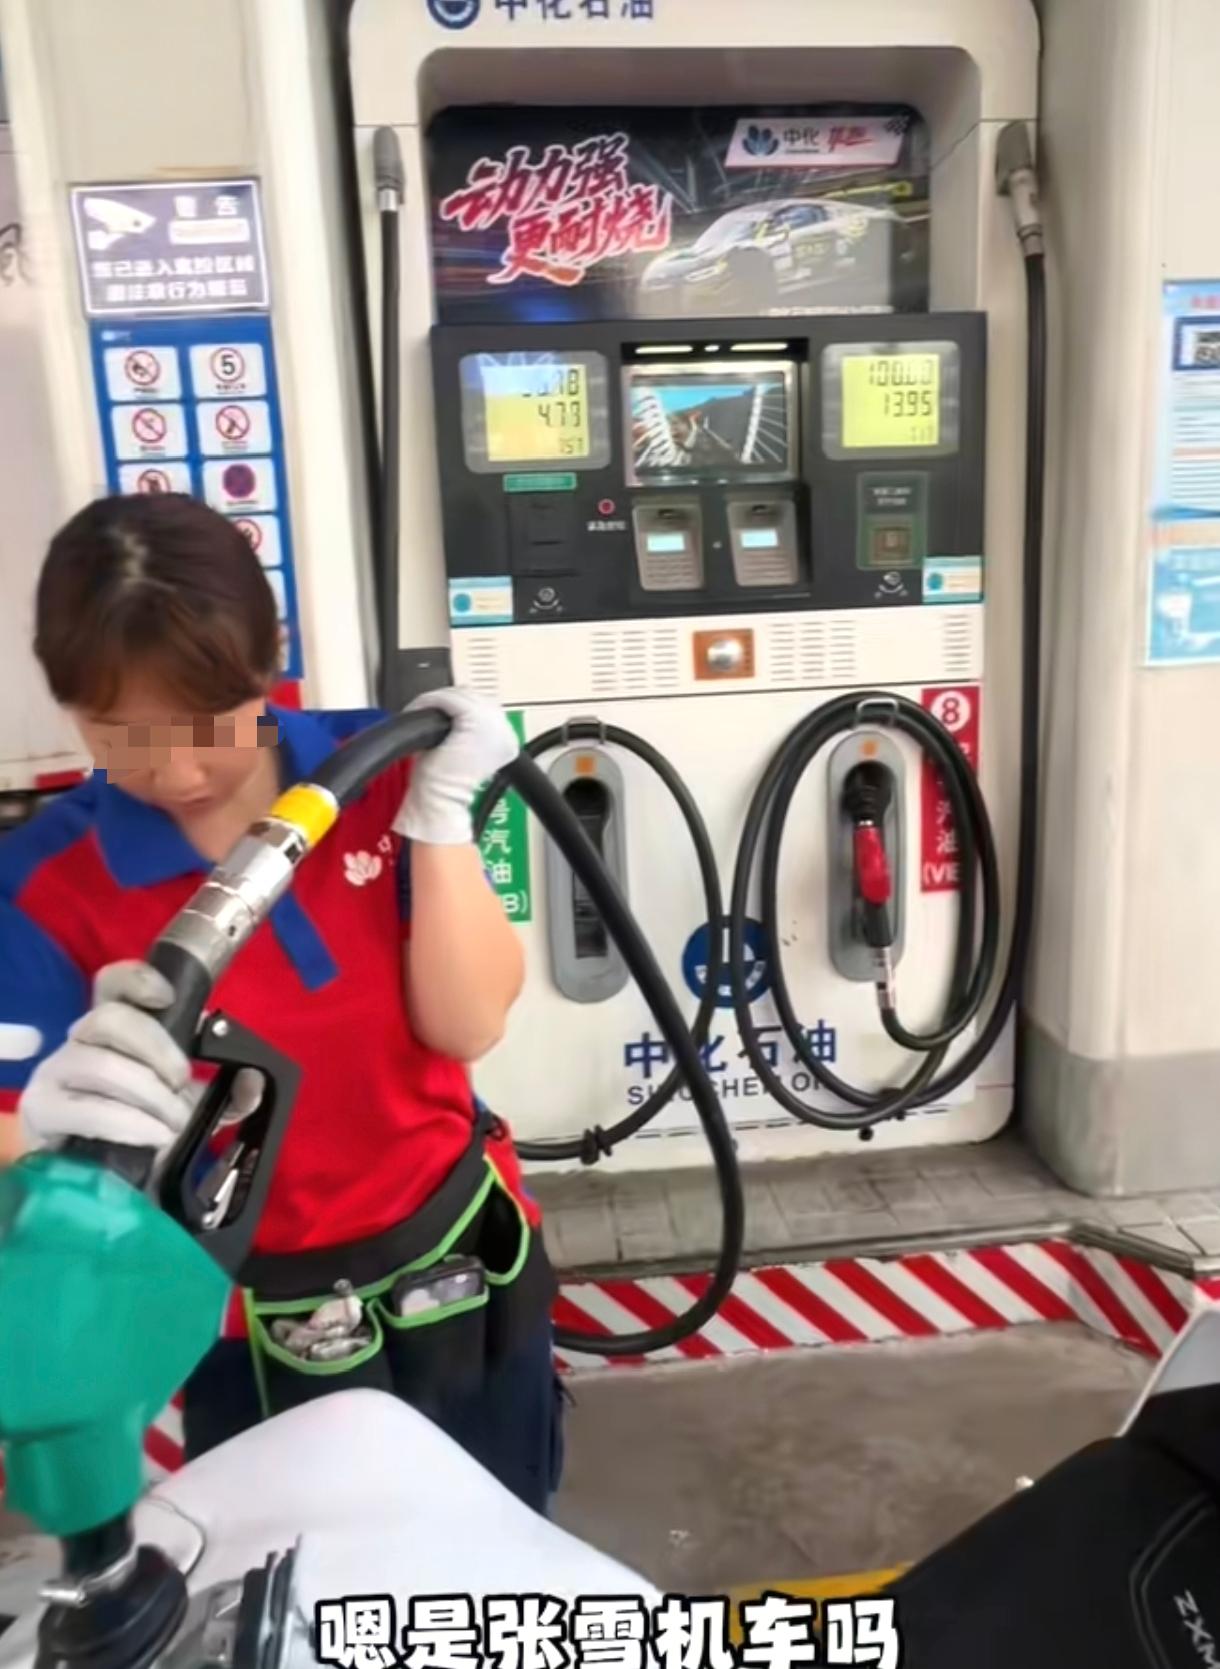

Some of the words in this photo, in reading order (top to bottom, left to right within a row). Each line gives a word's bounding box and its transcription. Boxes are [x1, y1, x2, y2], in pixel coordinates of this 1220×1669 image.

[494, 0, 655, 21] 中化石油
[440, 132, 629, 231] 动力强
[486, 184, 672, 286] 更耐烧
[221, 354, 236, 376] 5
[942, 698, 960, 724] 8
